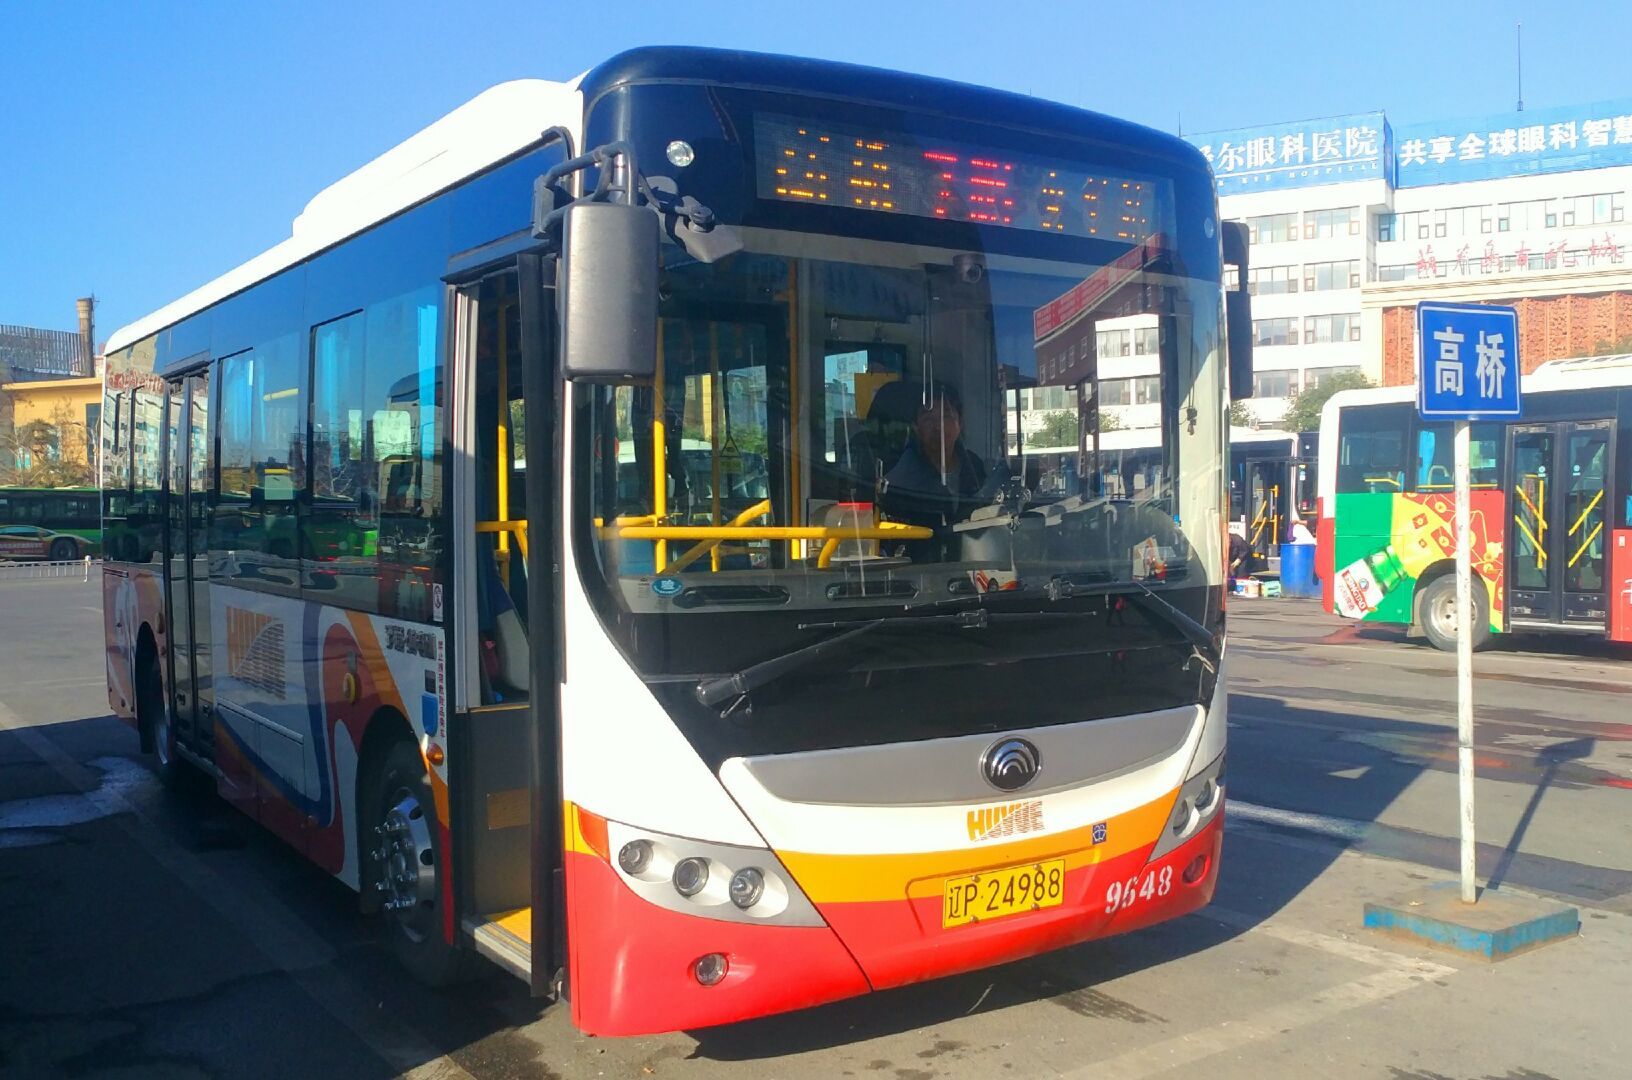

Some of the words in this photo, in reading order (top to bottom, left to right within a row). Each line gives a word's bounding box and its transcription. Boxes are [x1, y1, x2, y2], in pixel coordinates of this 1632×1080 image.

[1400, 114, 1632, 167] 共享全球眼科智慧
[1433, 326, 1507, 400] 高桥
[1105, 865, 1173, 913] 9648
